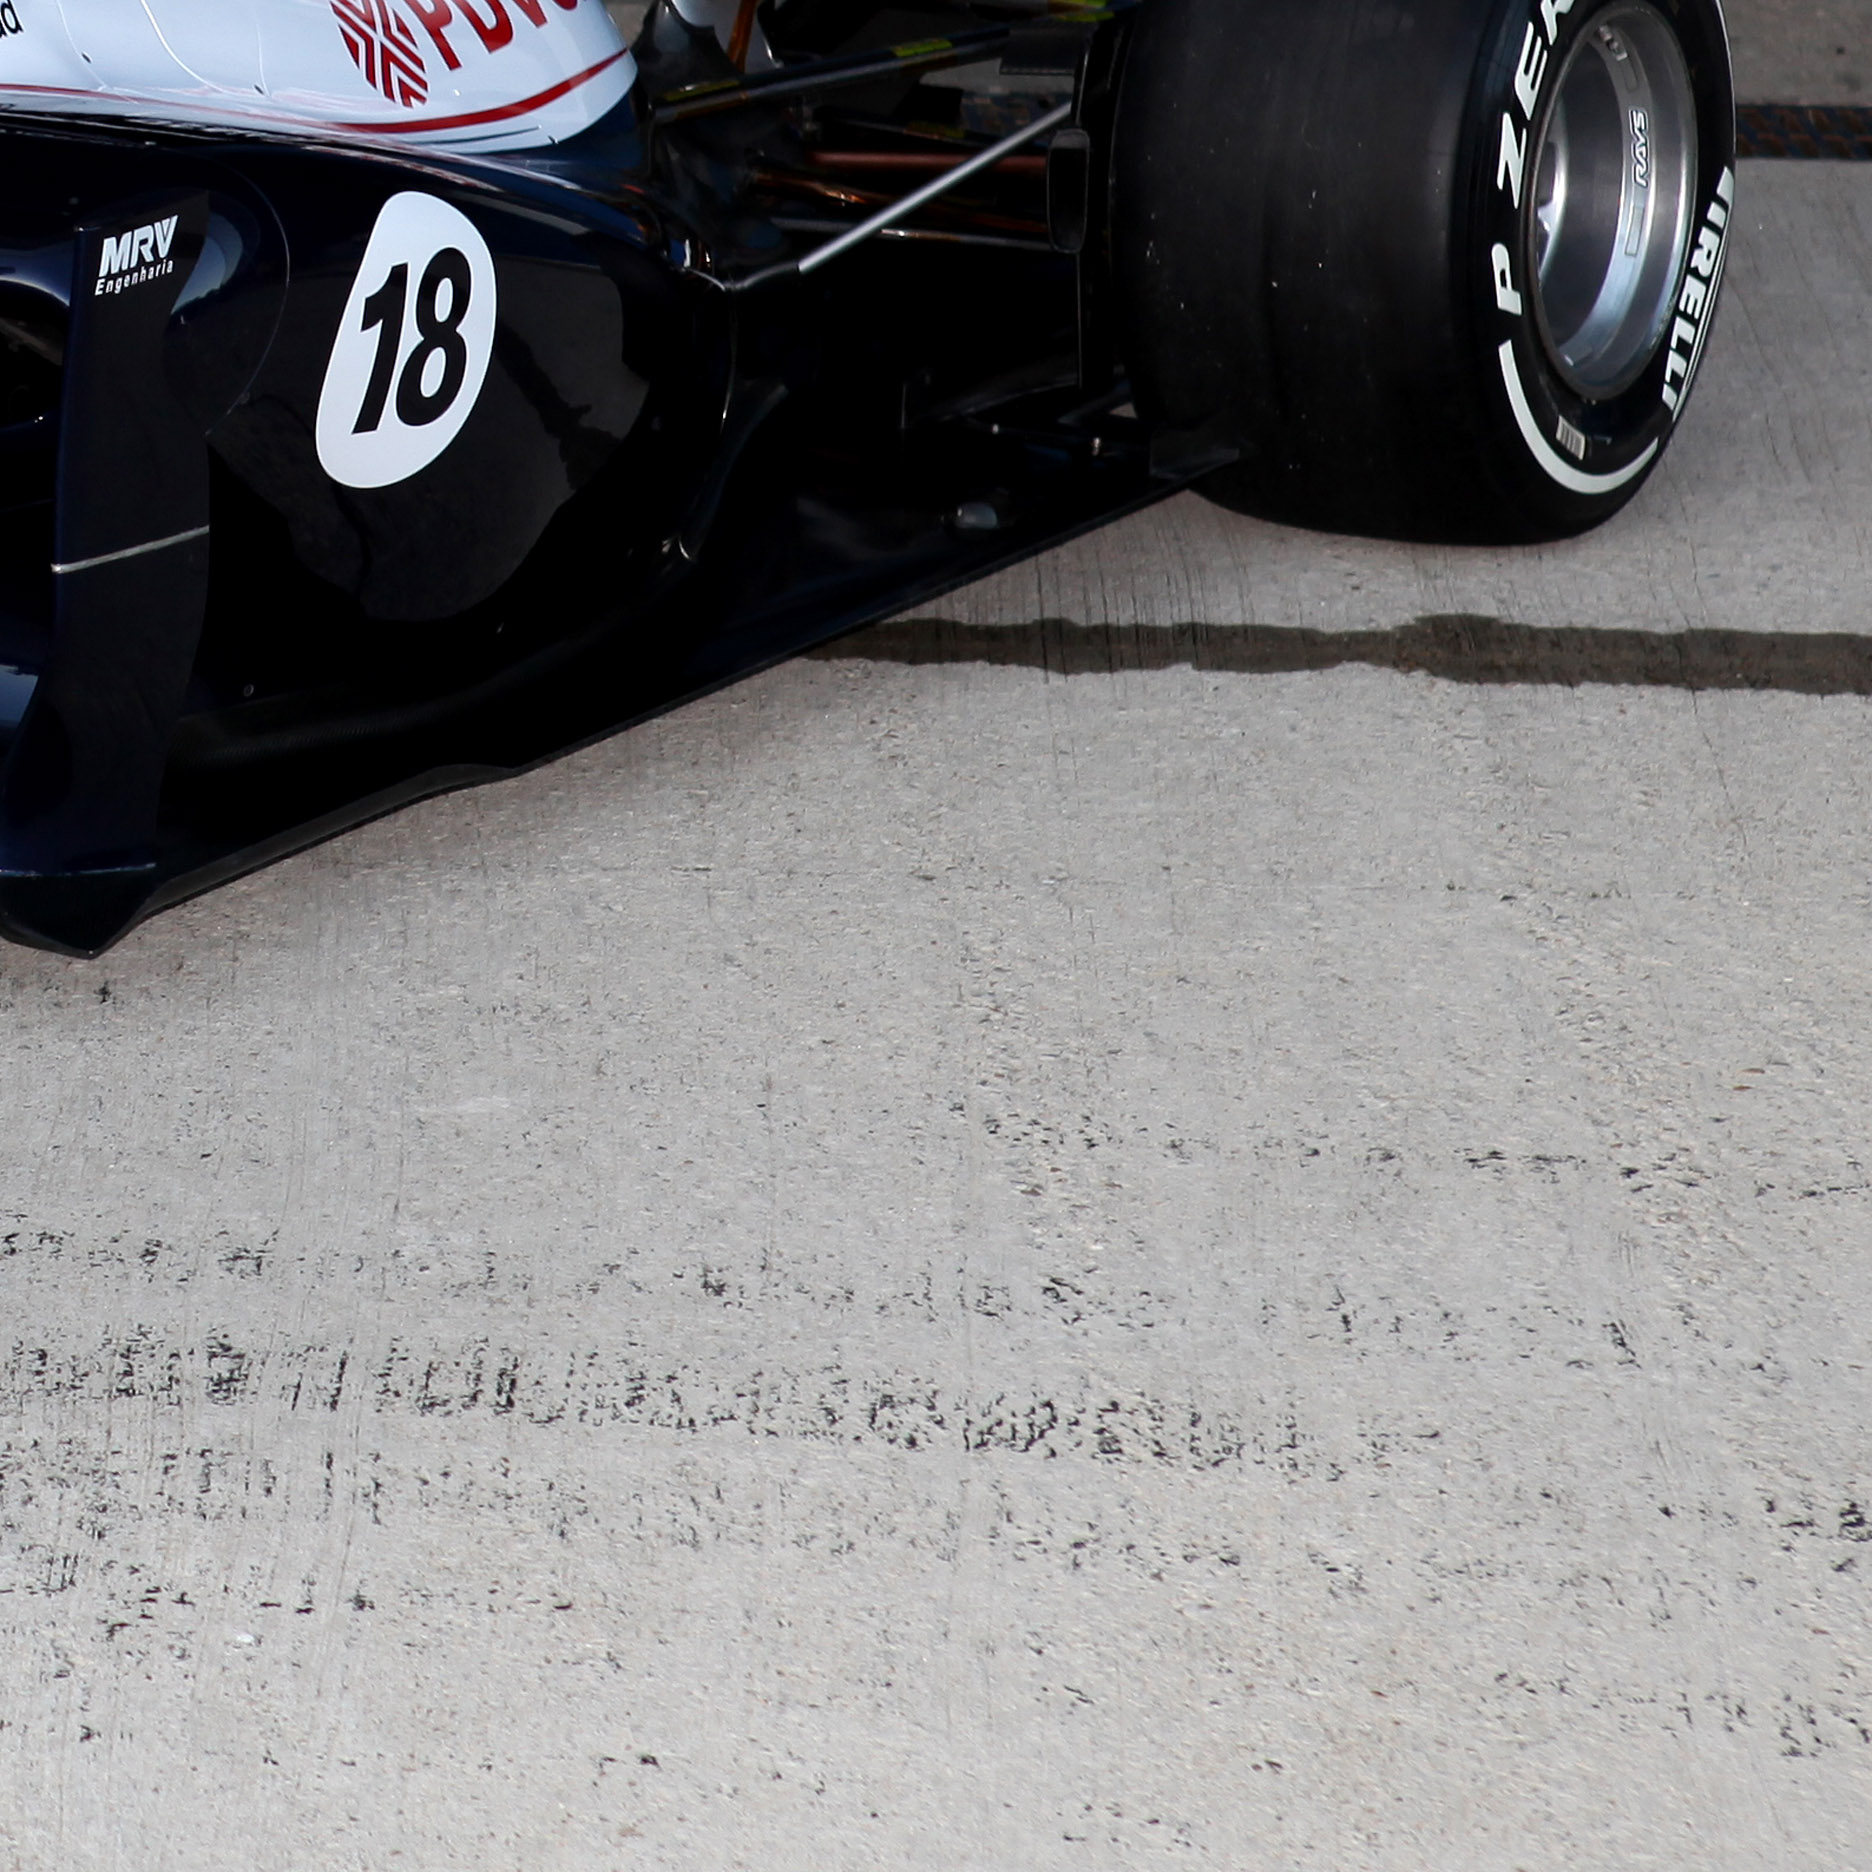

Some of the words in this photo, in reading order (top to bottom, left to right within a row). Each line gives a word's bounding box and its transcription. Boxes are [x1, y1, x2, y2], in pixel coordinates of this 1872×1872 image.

[94, 259, 174, 296] Engenharia
[98, 214, 179, 278] MRV
[1492, 243, 1523, 316] P
[351, 247, 472, 434] 18
